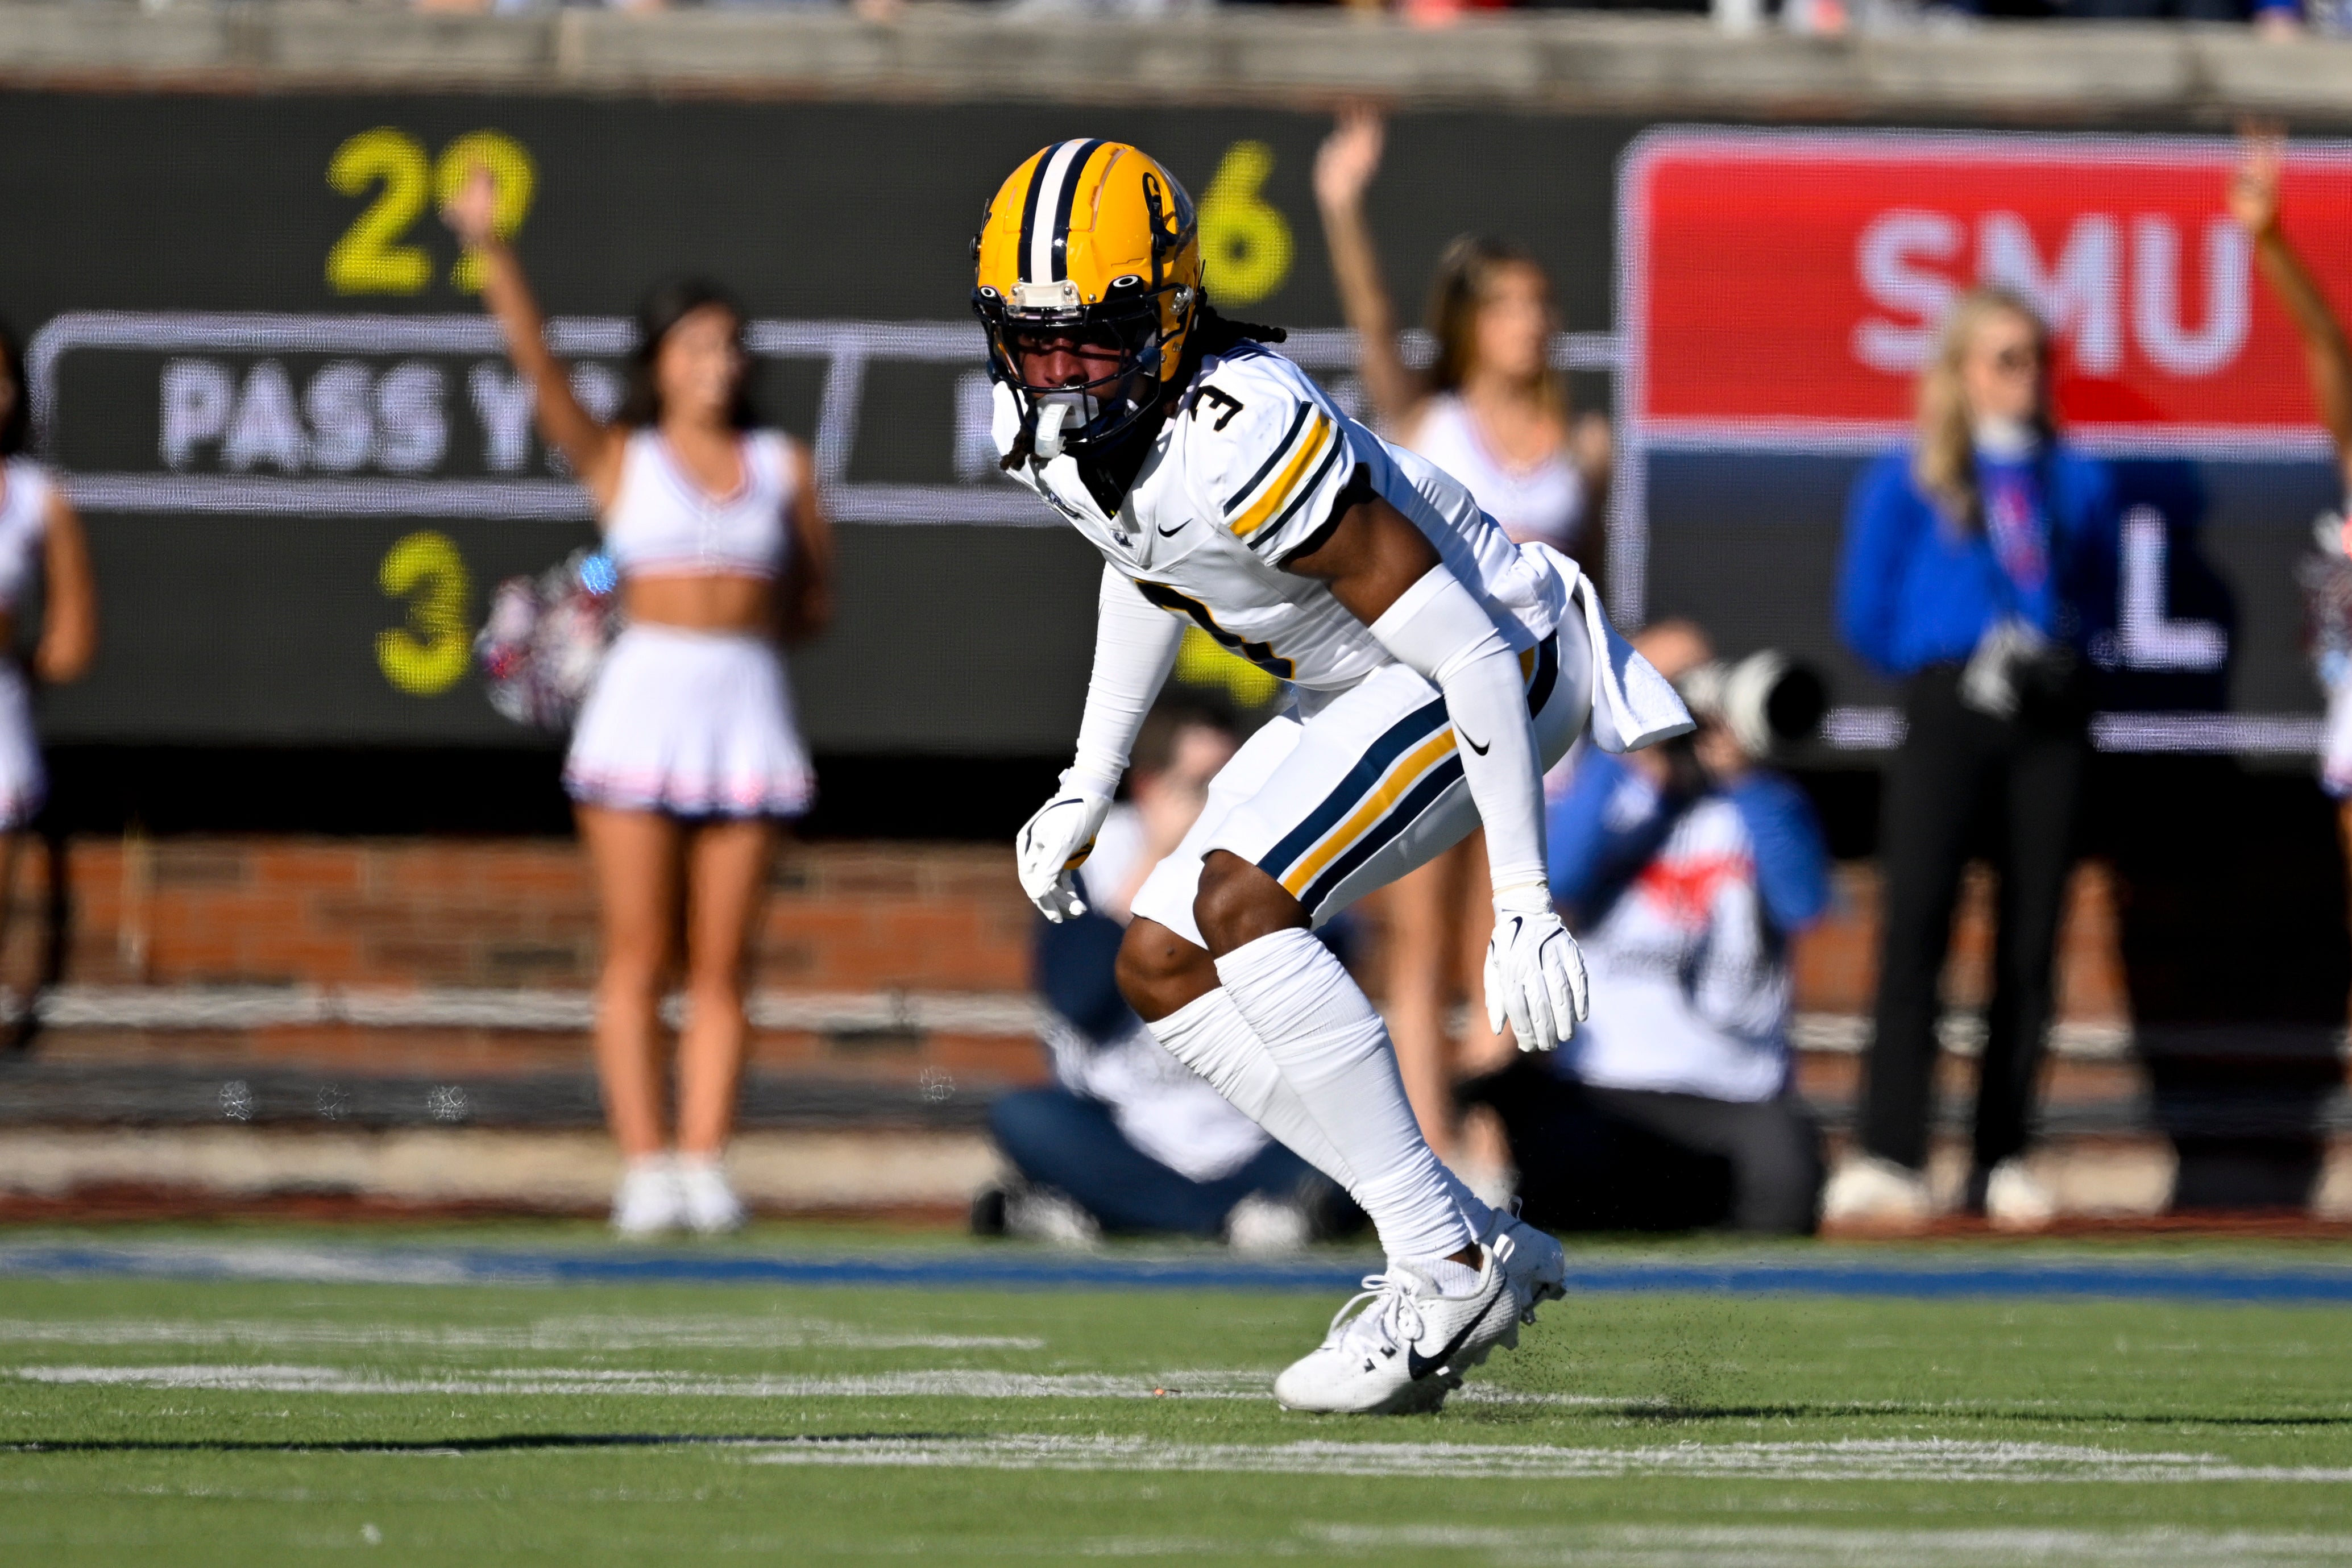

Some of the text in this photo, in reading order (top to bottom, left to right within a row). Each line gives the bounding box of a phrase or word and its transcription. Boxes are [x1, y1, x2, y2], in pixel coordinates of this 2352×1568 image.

[326, 127, 534, 294] 29
[1197, 141, 1293, 305] 6
[1853, 208, 2253, 375] SMU
[160, 358, 445, 472] PASS
[1190, 385, 1245, 432] 3
[375, 530, 471, 693] 3
